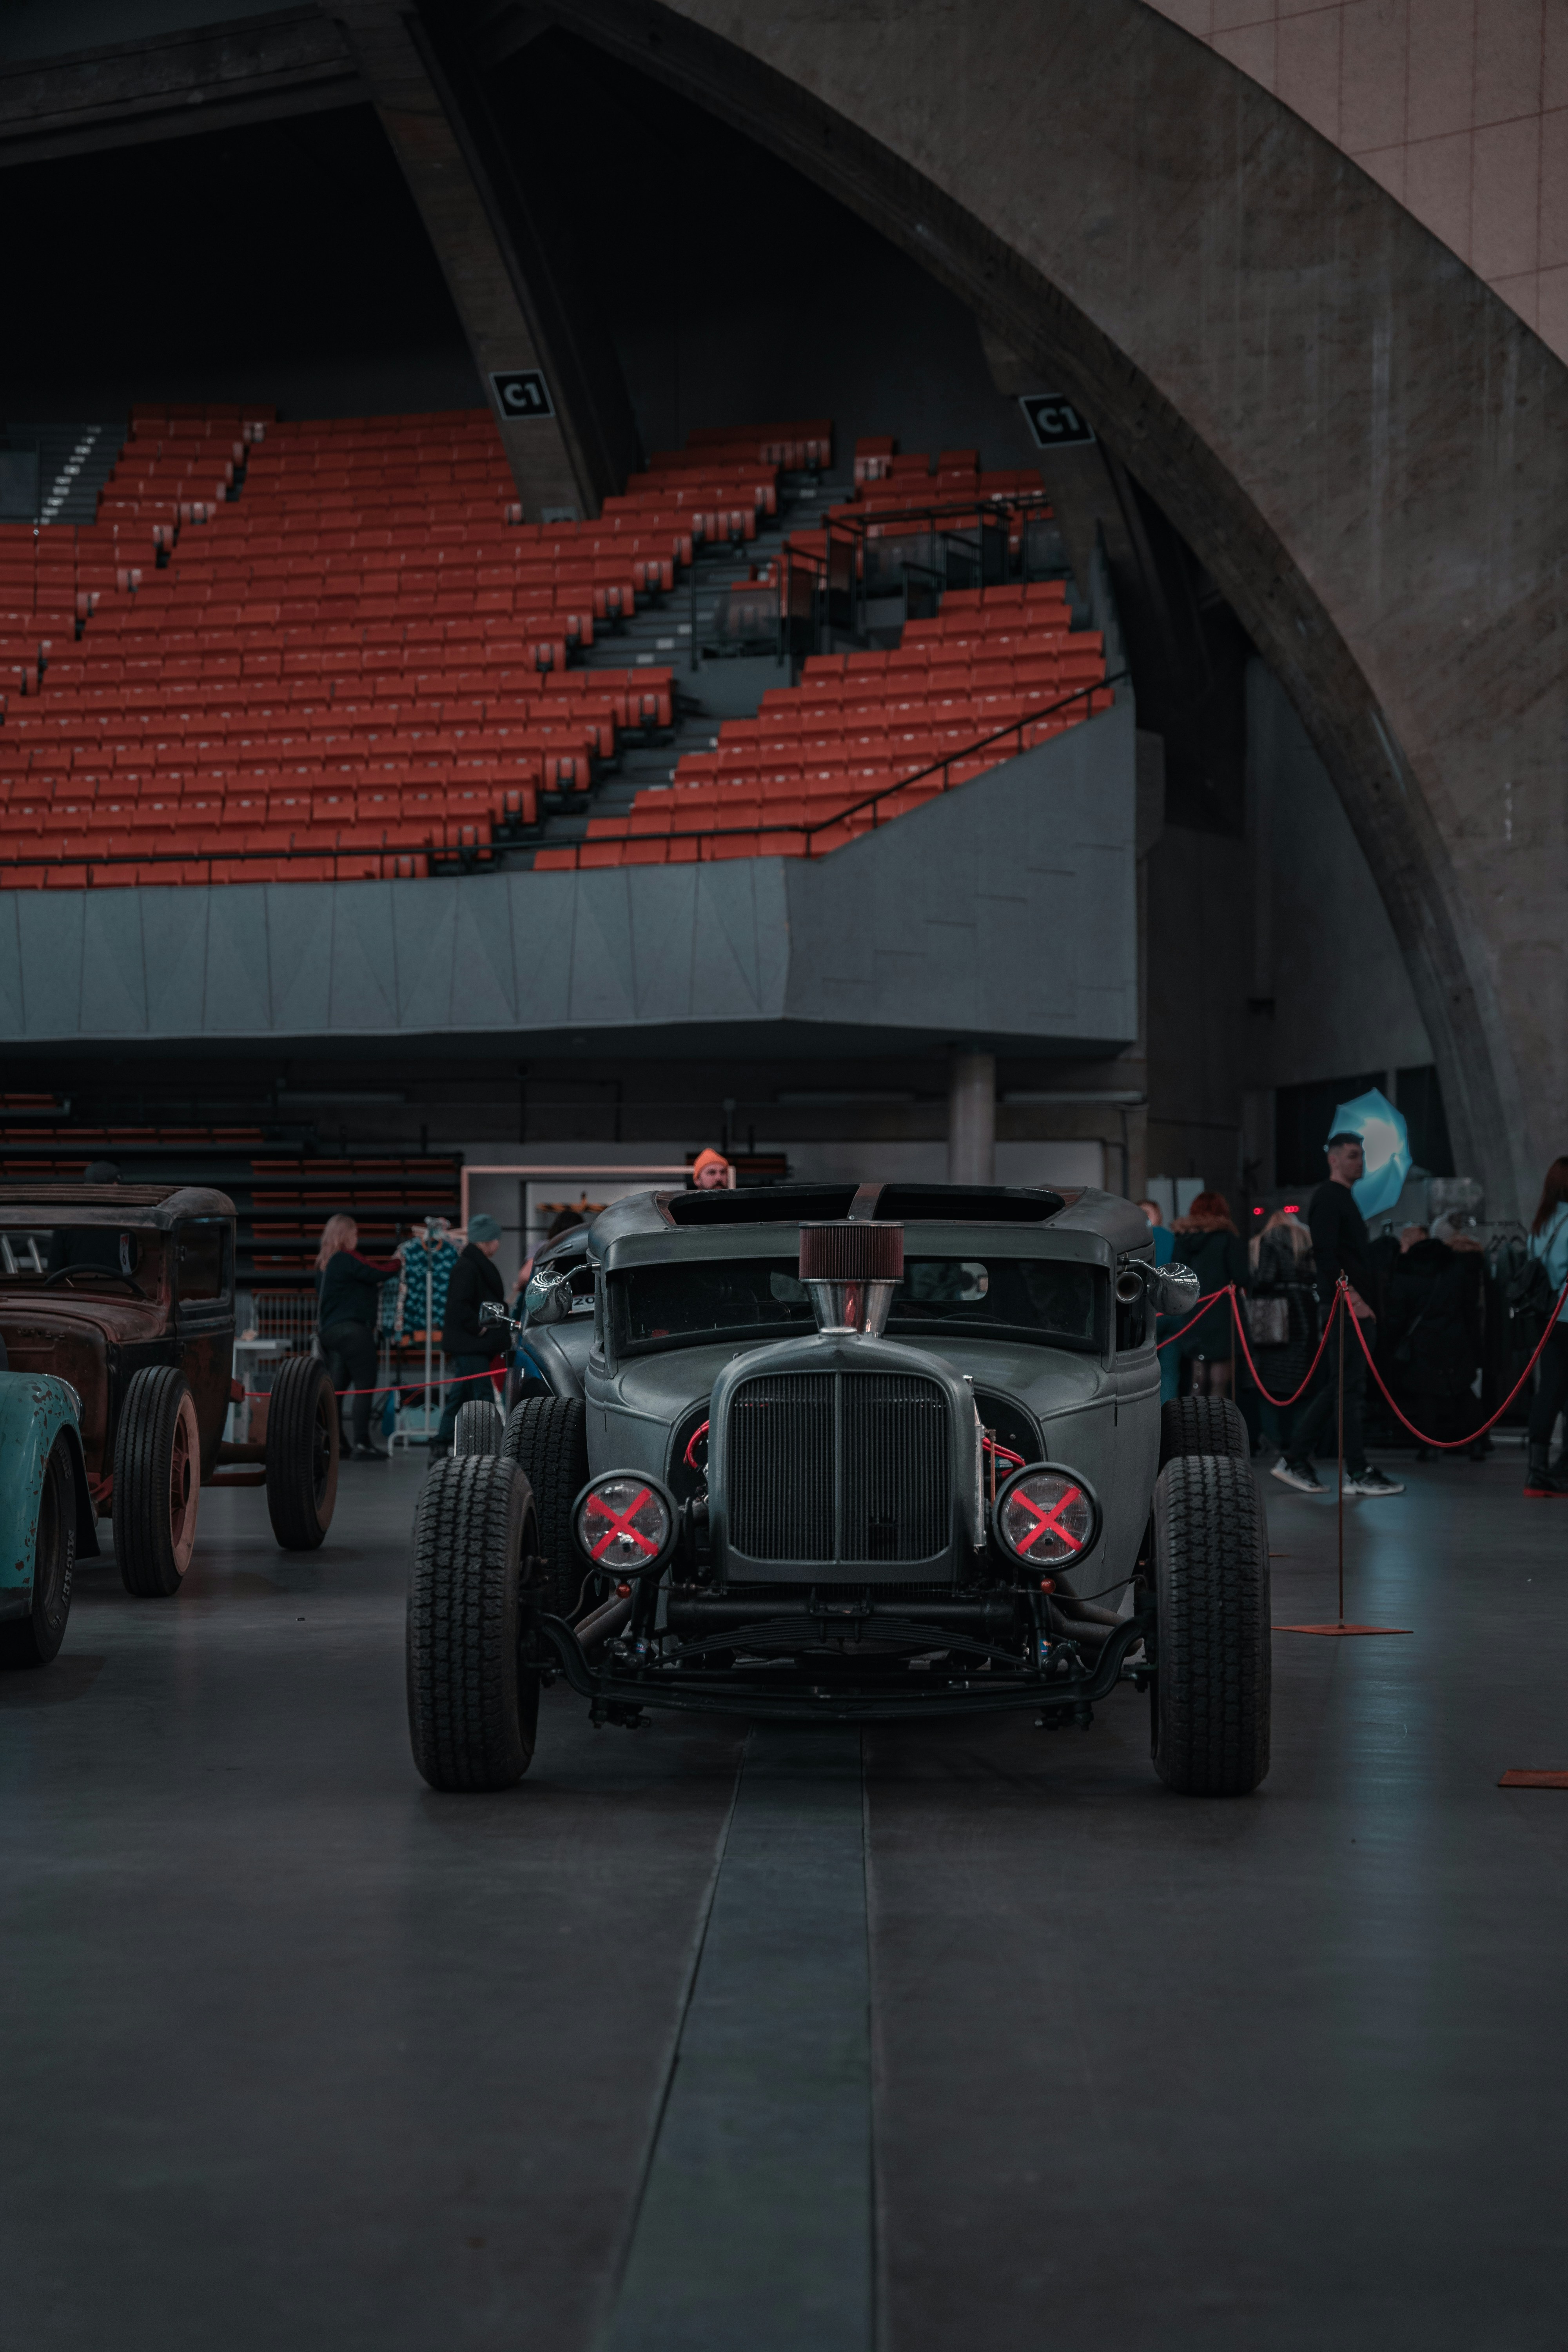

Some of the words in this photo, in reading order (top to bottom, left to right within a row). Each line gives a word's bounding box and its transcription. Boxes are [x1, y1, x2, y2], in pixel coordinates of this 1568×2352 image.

[503, 382, 543, 408] C1
[1036, 406, 1080, 434] C1
[61, 1529, 75, 1608] MICKEY
